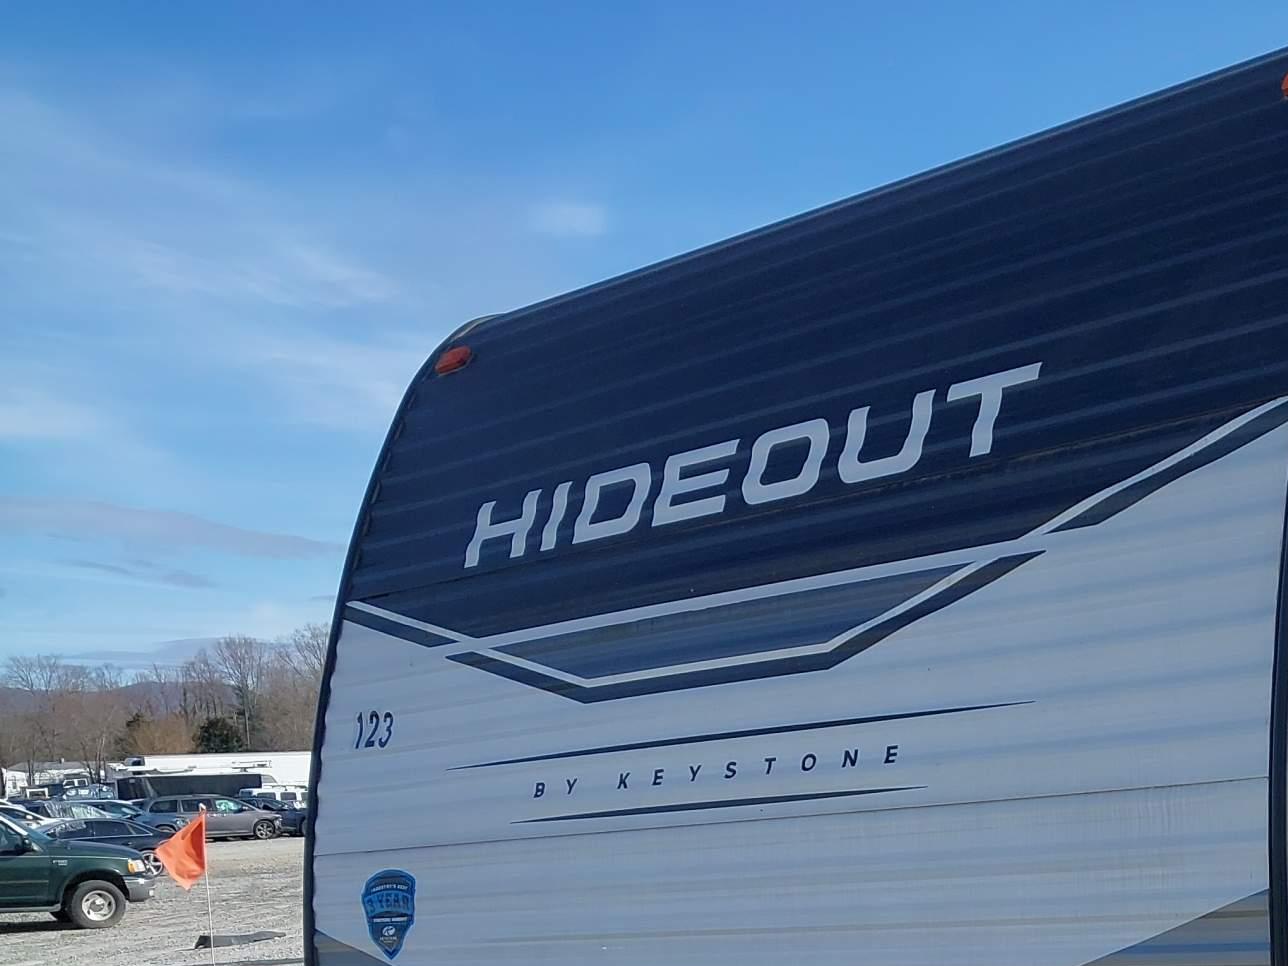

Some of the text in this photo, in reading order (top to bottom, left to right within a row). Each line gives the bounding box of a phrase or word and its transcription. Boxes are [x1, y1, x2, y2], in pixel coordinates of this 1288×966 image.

[464, 362, 1042, 569] HIDEOUT
[354, 710, 394, 750] 123
[533, 744, 899, 799] BY KEYSTONE
[376, 893, 410, 912] YEAR
